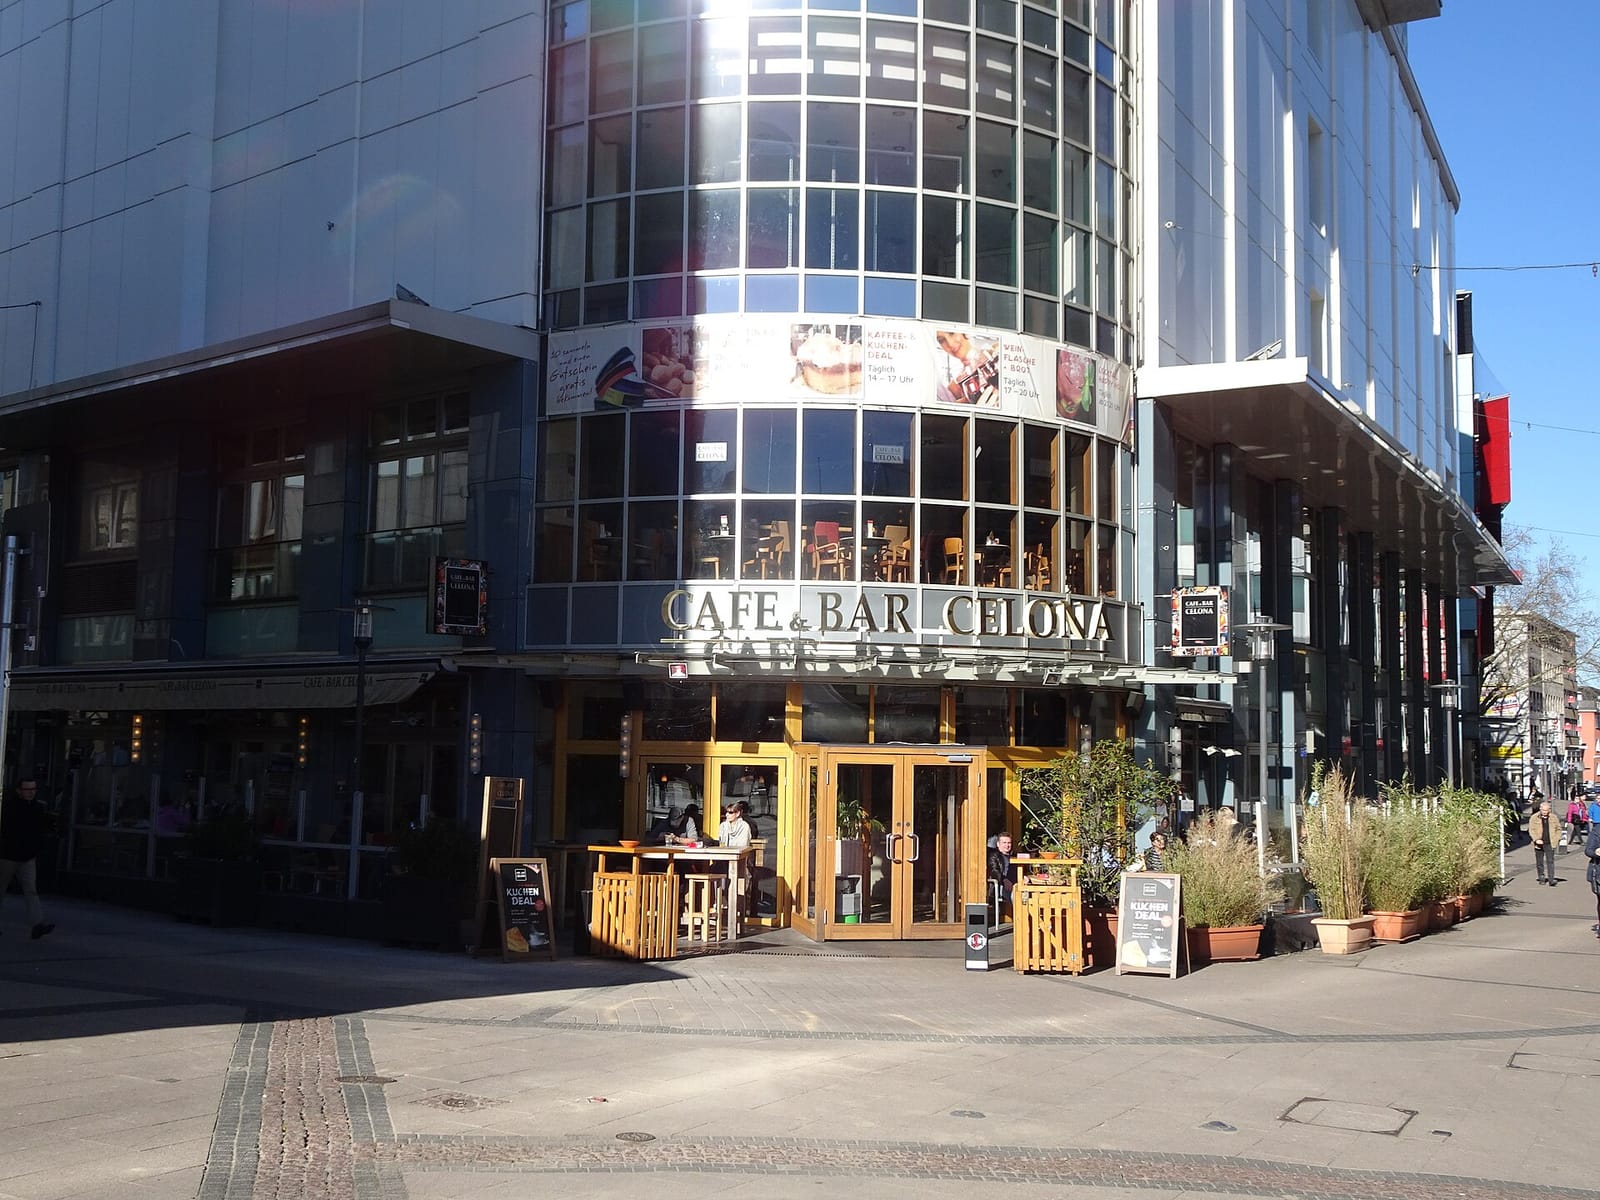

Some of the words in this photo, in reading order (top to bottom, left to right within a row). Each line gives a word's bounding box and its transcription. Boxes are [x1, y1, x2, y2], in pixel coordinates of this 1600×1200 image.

[868, 351, 893, 360] DEAL
[1003, 354, 1036, 366] FLASCHE
[550, 362, 597, 382] Gutschein
[868, 374, 877, 382] 14
[888, 375, 897, 383] 17
[899, 376, 914, 384] Uhr
[560, 376, 586, 398] gratis
[1029, 391, 1040, 399] Uhr
[661, 590, 783, 631] CAFE
[789, 611, 812, 631] &
[817, 592, 914, 633] BAR
[943, 596, 1115, 640] CELONA
[506, 887, 540, 896] KUCHEN
[512, 897, 536, 905] DEAL
[1130, 902, 1169, 911] KUCHEN
[1135, 911, 1161, 920] DEAL
